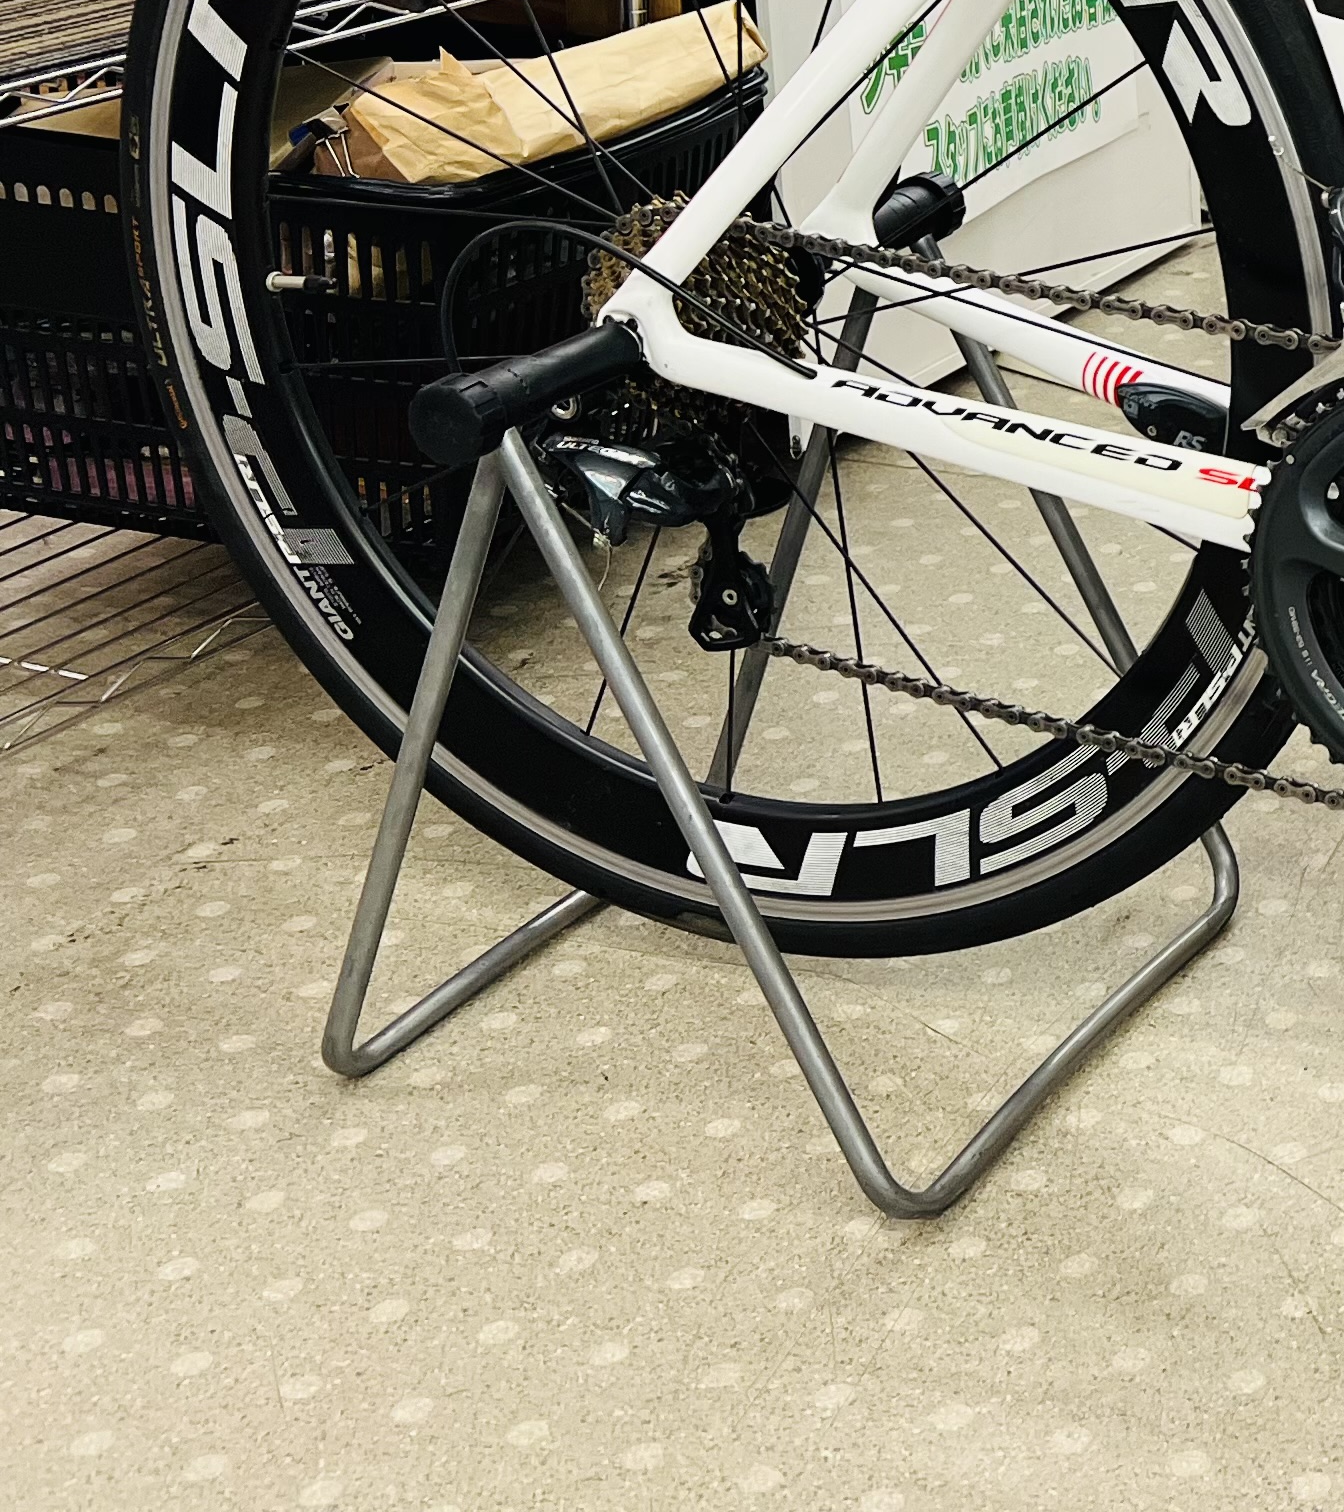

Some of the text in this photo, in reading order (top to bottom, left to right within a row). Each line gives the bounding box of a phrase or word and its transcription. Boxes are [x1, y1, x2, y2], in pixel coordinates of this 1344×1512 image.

[138, 269, 168, 367] ULTRA
[831, 378, 1183, 472] ADVANCED
[294, 565, 355, 641] GIANT
